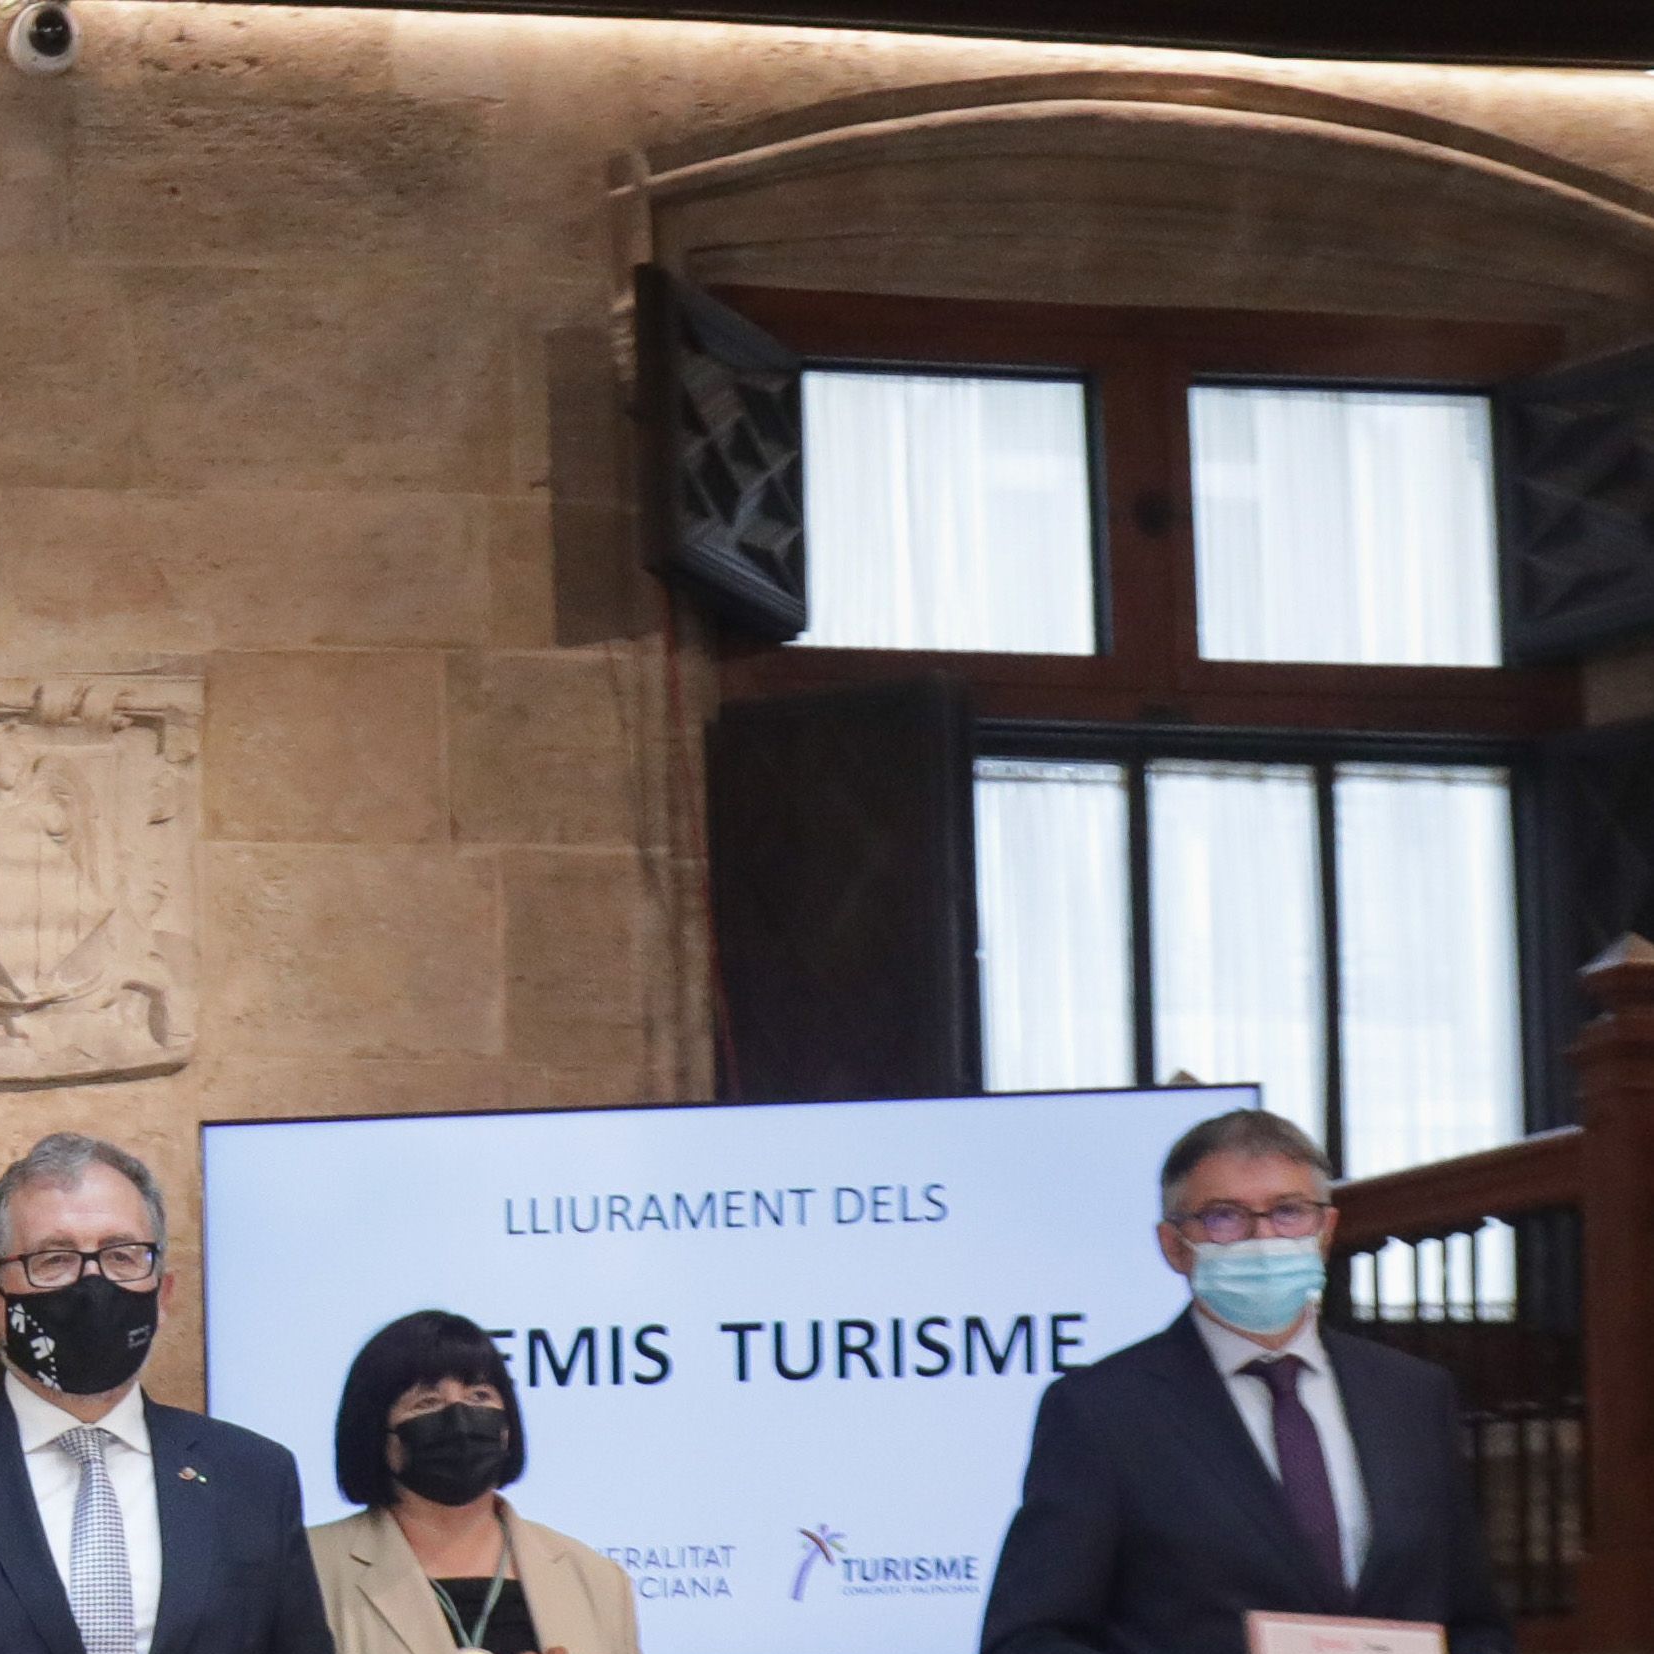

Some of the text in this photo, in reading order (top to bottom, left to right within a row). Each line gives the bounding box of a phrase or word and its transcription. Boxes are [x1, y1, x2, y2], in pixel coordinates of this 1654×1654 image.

[504, 1183, 949, 1235] LLIURAMENT DELS
[719, 1313, 1085, 1382] TURISME
[603, 1545, 737, 1569] ERALITAT
[841, 1555, 979, 1582] TURISME
